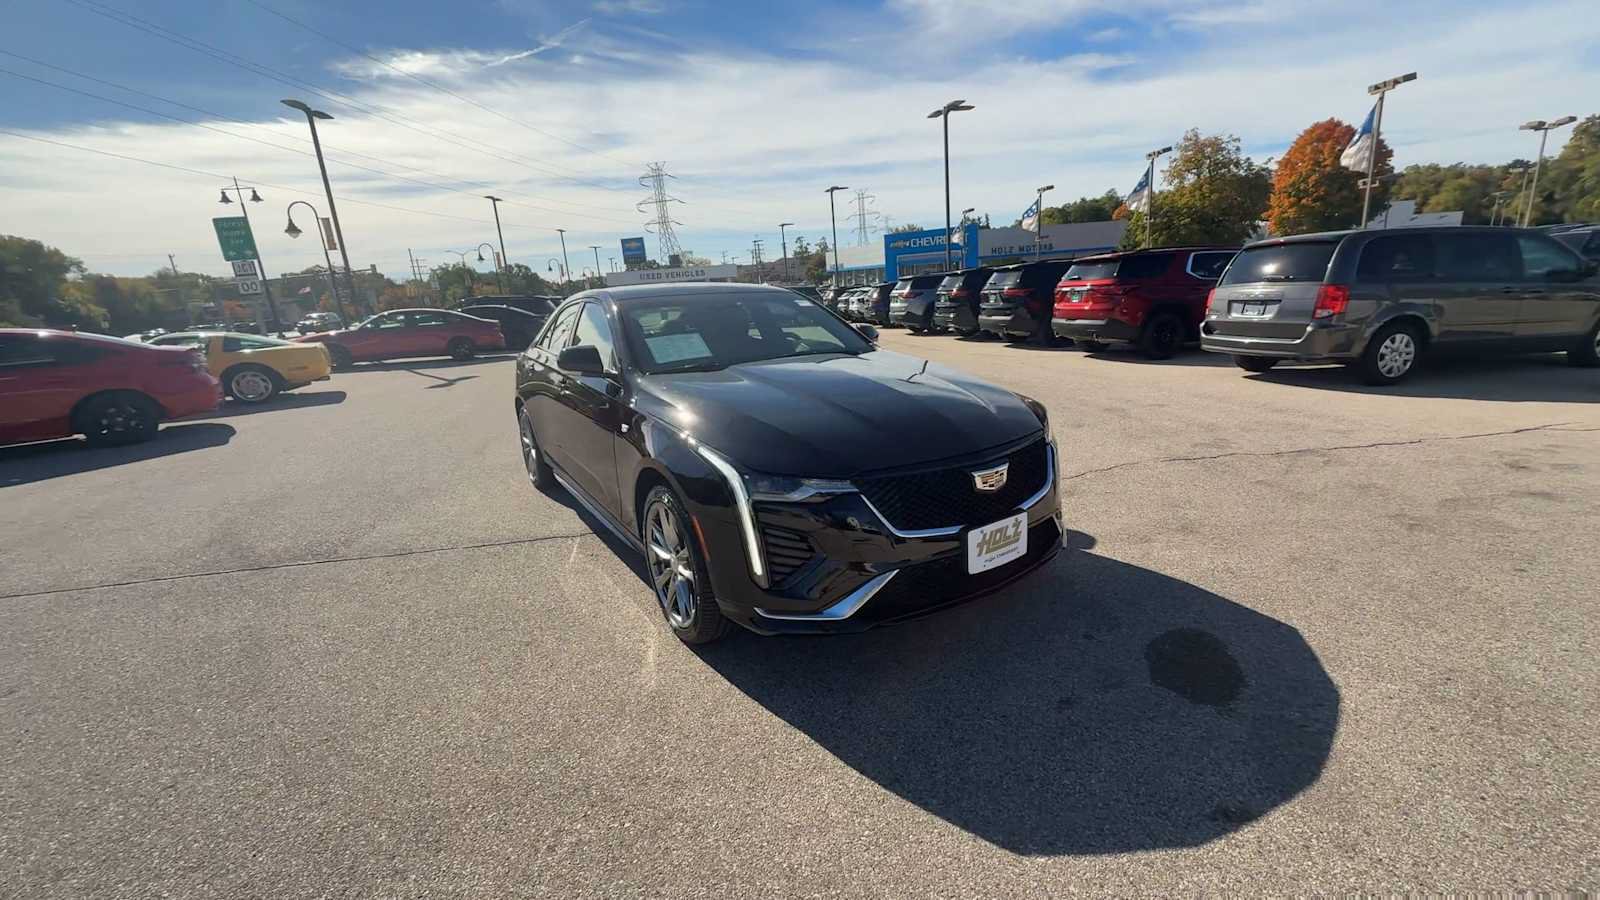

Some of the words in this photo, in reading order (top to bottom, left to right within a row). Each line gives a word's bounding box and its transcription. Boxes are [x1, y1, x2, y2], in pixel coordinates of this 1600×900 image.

[639, 271, 662, 280] USED
[664, 269, 706, 279] VEHICLES
[976, 516, 1023, 557] HOLZ
